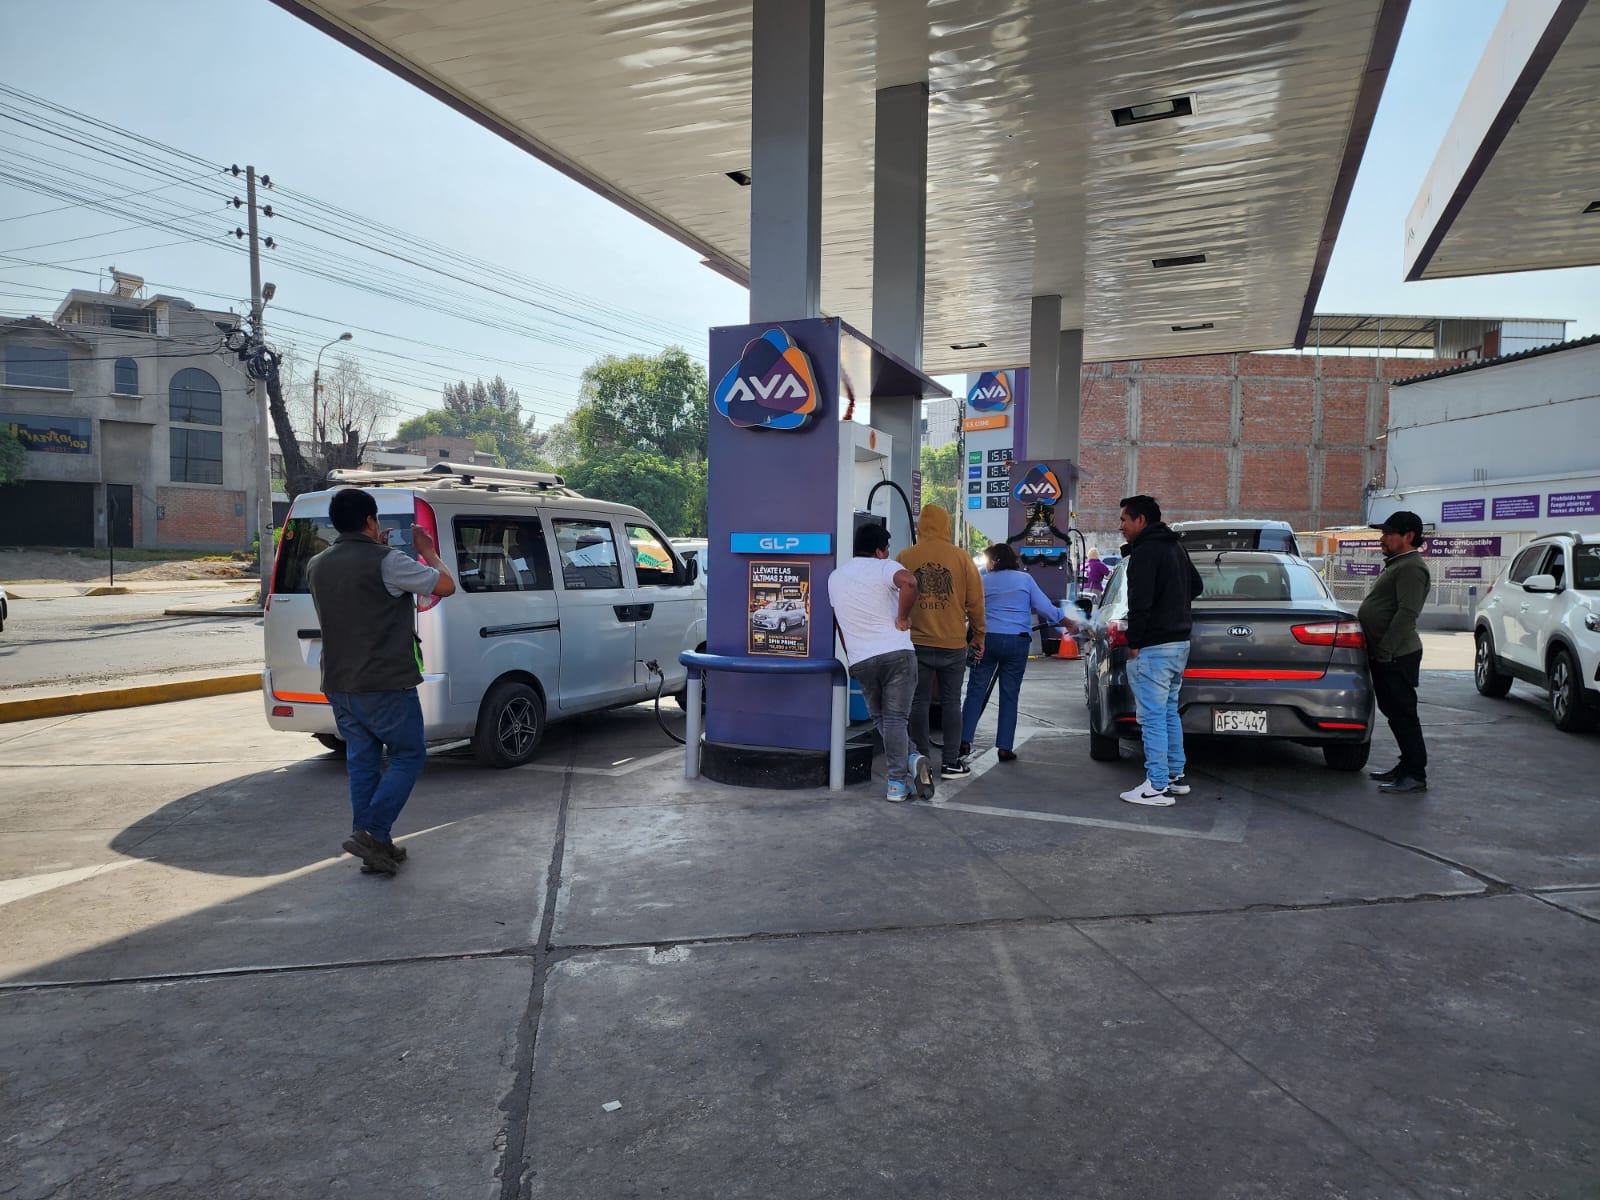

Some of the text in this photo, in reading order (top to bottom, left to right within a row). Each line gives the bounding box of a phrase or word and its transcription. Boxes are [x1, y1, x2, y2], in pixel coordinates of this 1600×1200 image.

[725, 373, 807, 403] AVA
[971, 385, 1007, 401] AVA
[991, 450, 1013, 461] 15.67
[1017, 482, 1056, 495] AVA
[759, 537, 799, 550] GLP
[1449, 538, 1493, 547] combustible
[1444, 547, 1467, 555] fumar
[779, 567, 791, 575] LAS
[784, 575, 799, 583] SPIN
[919, 601, 947, 610] OBEY
[1216, 715, 1266, 731] AFS-447
